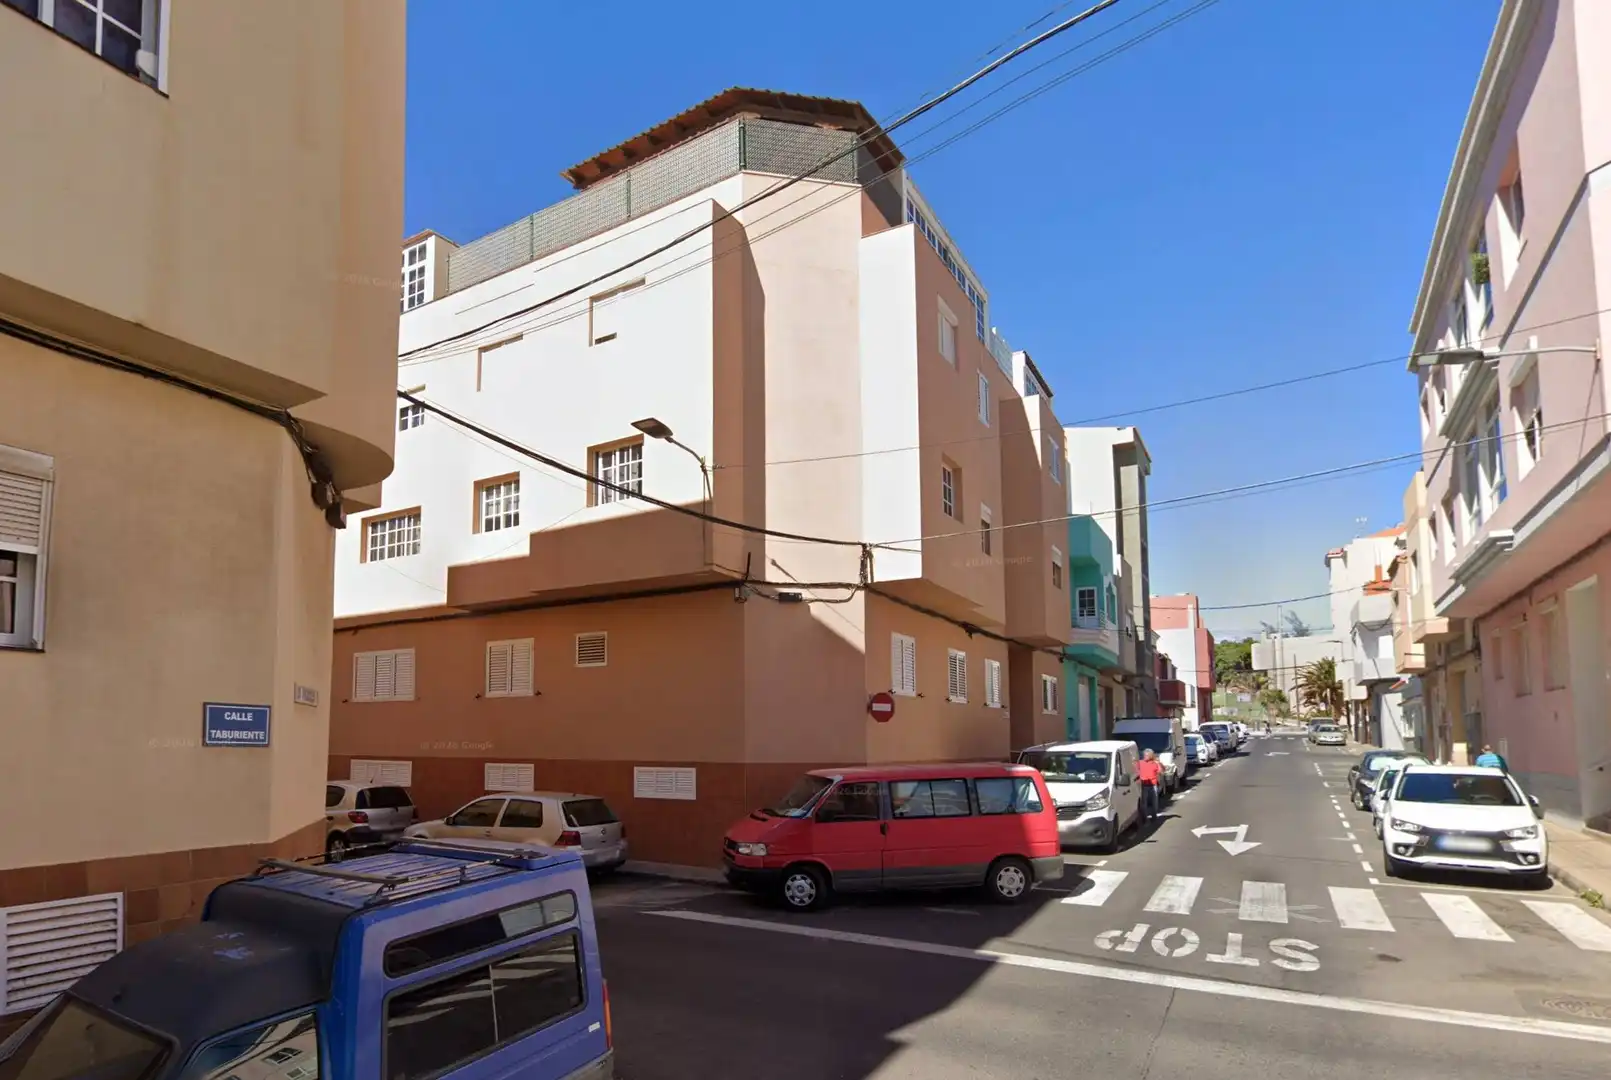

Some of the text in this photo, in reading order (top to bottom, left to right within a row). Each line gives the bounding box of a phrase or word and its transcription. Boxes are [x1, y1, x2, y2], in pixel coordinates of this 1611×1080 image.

[224, 711, 253, 722] CALLE
[210, 729, 265, 740] TABURIENTE
[1094, 923, 1321, 972] STOP
